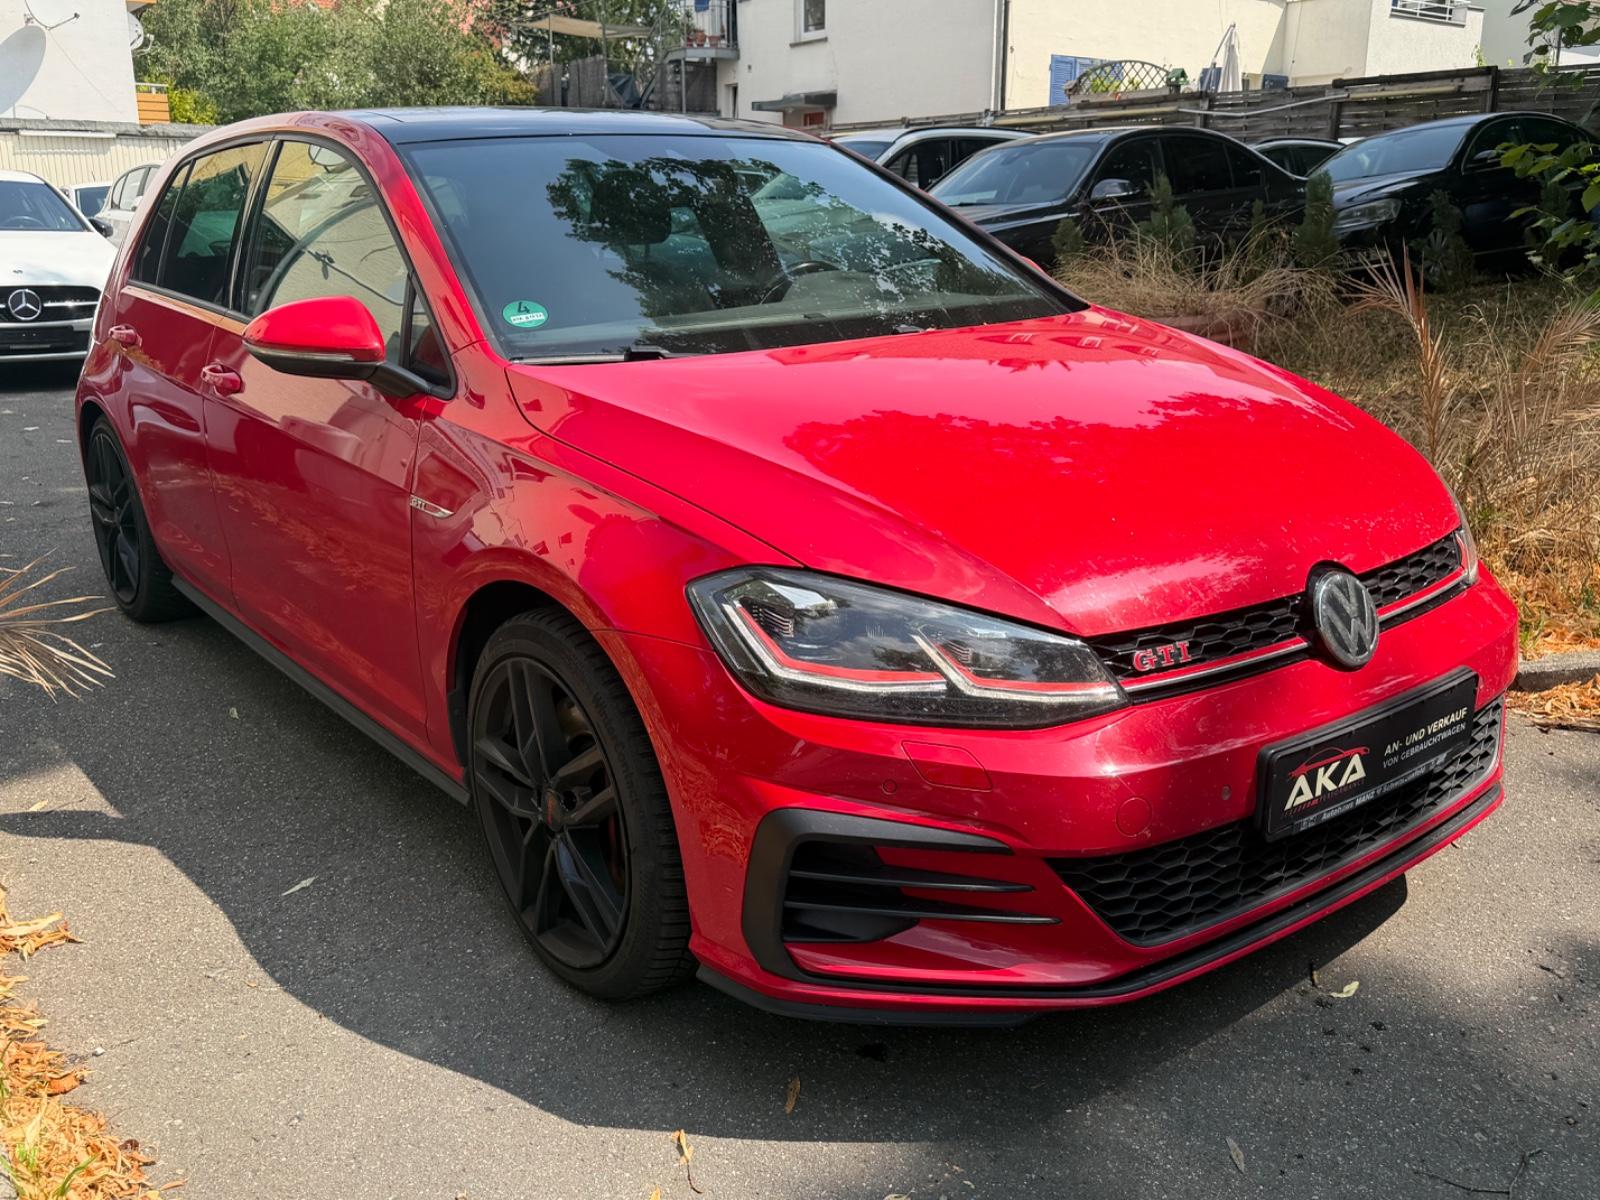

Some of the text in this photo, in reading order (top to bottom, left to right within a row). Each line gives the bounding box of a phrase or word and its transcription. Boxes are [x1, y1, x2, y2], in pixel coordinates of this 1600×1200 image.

[517, 301, 530, 313] 4
[1133, 640, 1192, 671] GTI
[1383, 707, 1468, 756] AN- UND VERKAUF
[1383, 723, 1466, 769] VON GEBRAUCHTWAGEN
[1284, 753, 1367, 811] AKA
